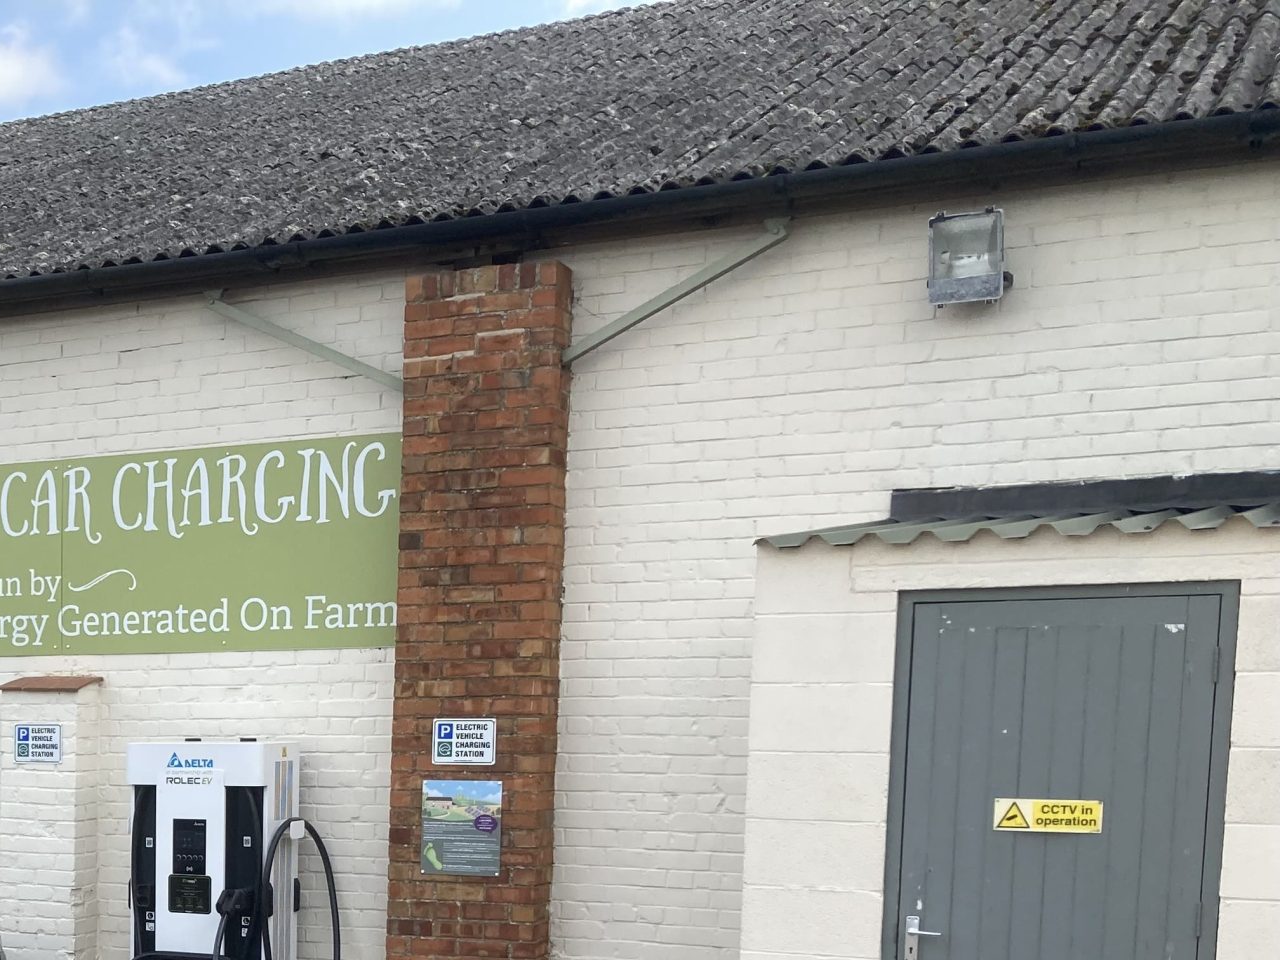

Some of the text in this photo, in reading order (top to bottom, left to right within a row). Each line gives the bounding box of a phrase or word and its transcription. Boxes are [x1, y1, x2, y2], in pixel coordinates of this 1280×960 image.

[0, 465, 103, 545] CAR
[112, 440, 398, 540] CHARGING
[28, 568, 62, 603] by
[57, 597, 230, 637] Generated
[239, 597, 294, 632] On
[303, 594, 398, 630] Farm
[455, 723, 488, 731] ELECTRIC
[455, 732, 484, 740] VEHICLE
[455, 741, 491, 749] CHARGING
[454, 750, 485, 758] STATION
[184, 758, 214, 768] DELTA
[165, 776, 213, 785] ROLEC EV
[1040, 804, 1093, 815] CCTV in
[1035, 817, 1097, 827] operation
